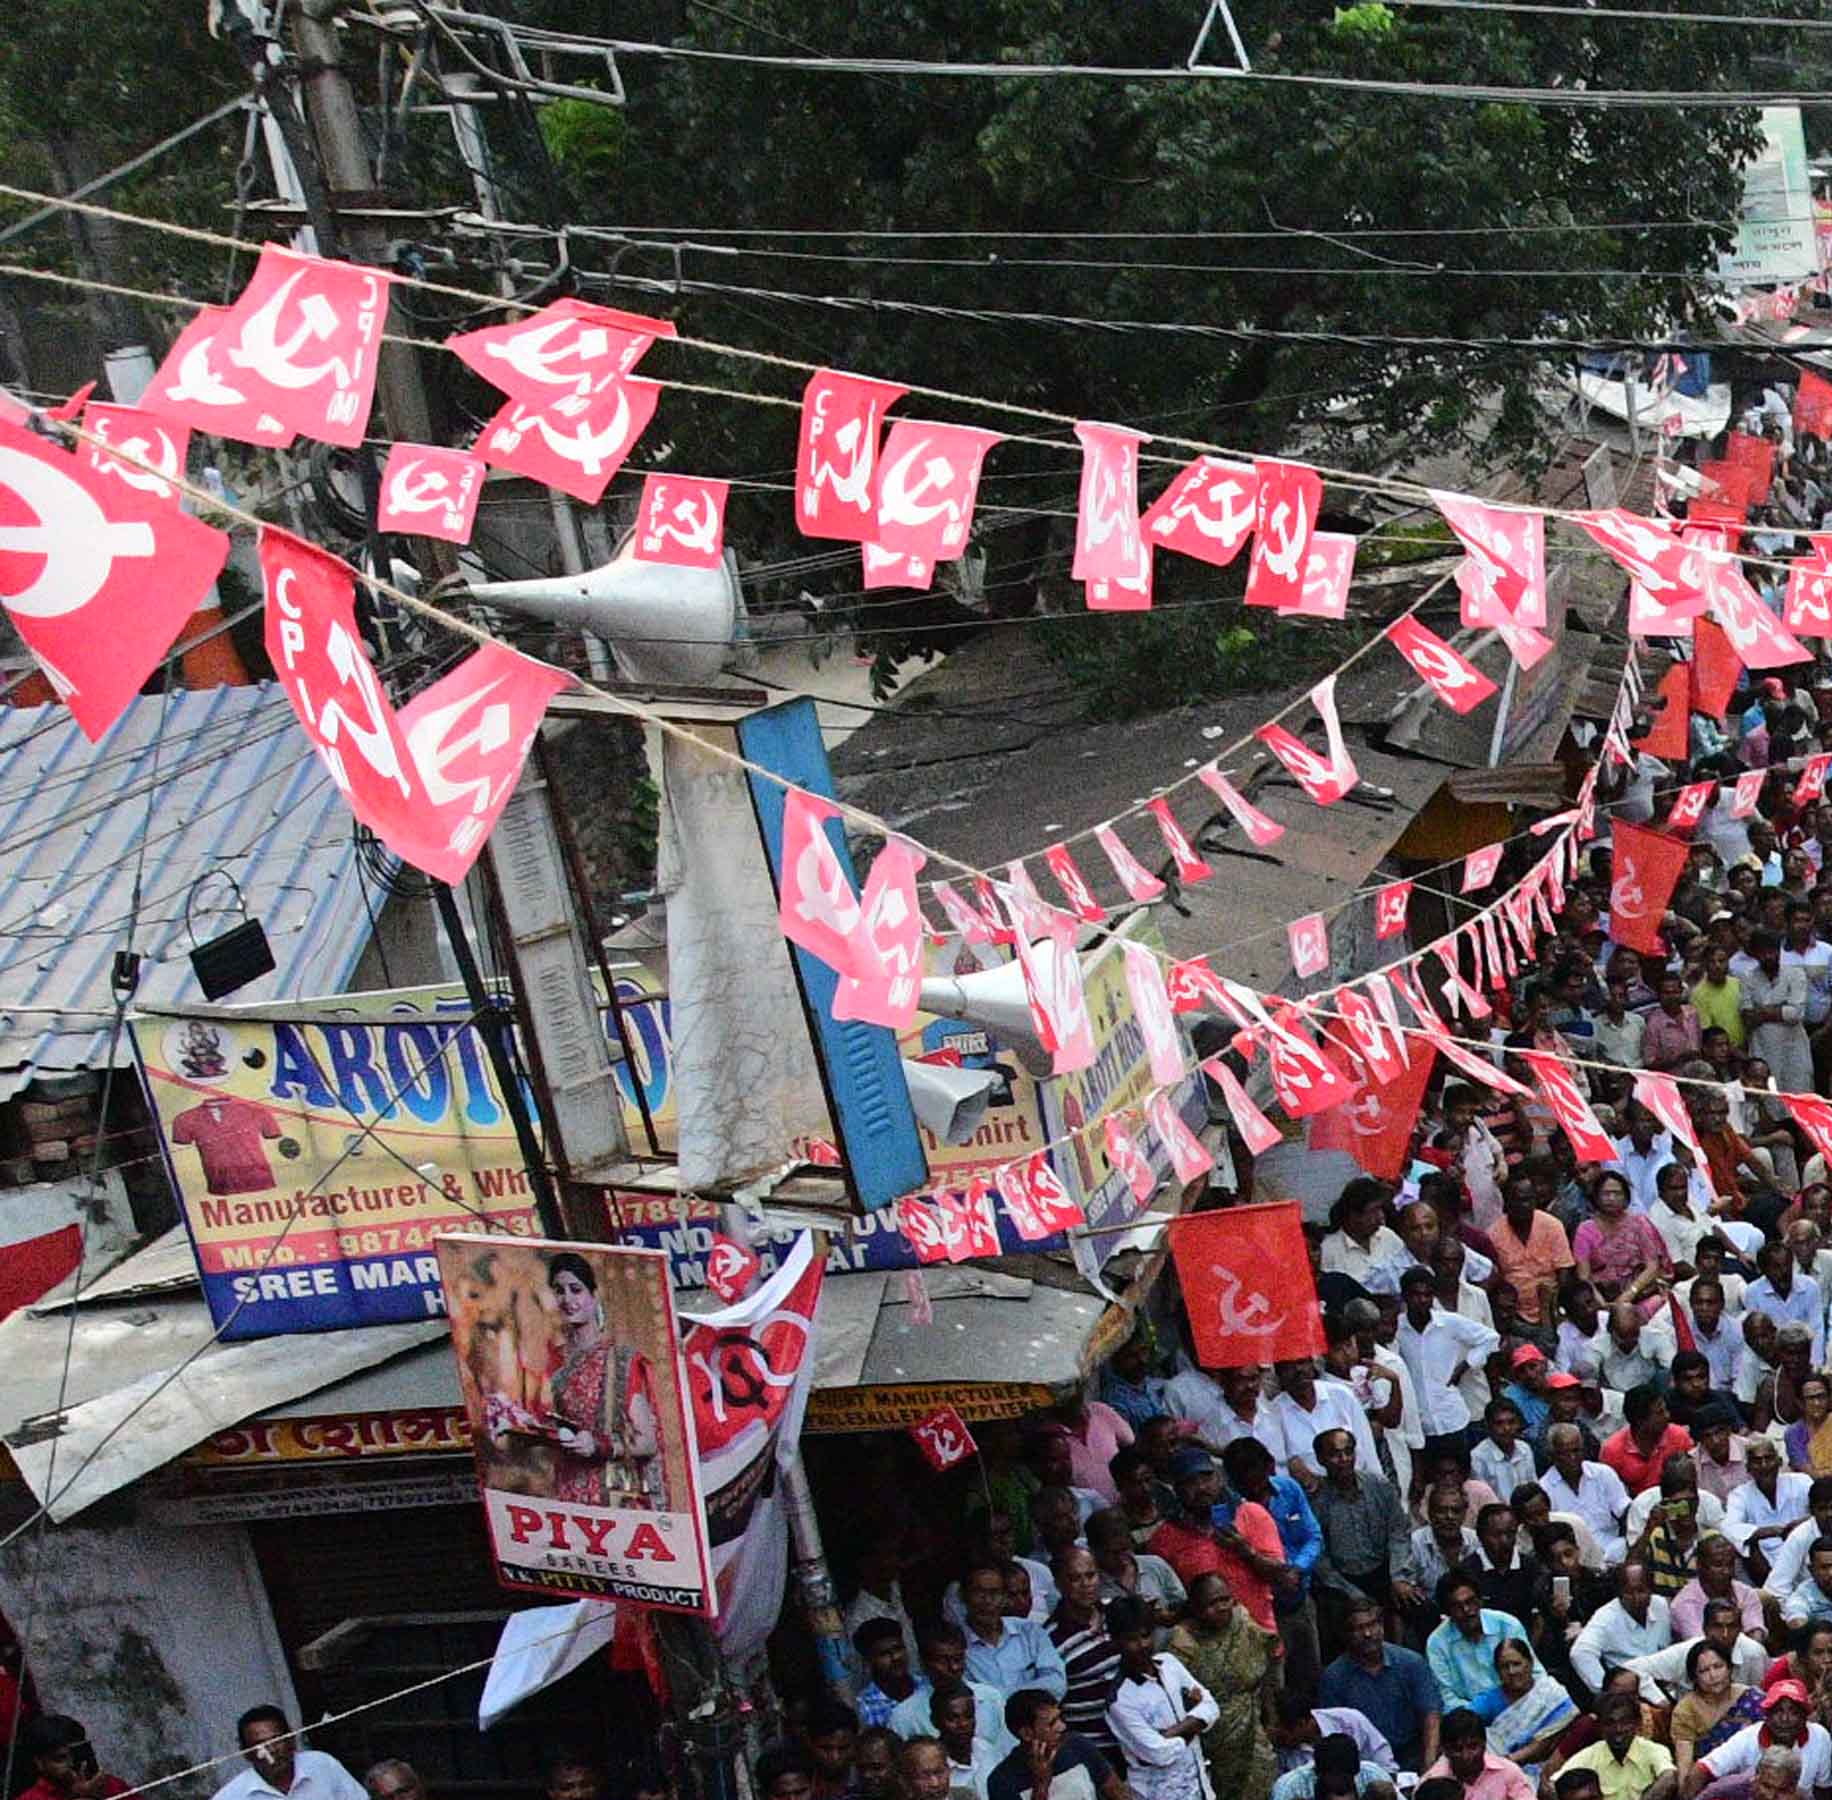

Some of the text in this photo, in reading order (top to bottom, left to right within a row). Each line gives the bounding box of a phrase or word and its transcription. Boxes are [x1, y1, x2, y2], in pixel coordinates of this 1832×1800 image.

[200, 1182, 429, 1230] Manufacturer
[441, 1173, 465, 1200] &
[232, 1267, 339, 1304] SREE
[506, 1504, 677, 1562] PIYA
[546, 1552, 637, 1578] SAREES
[612, 1581, 700, 1608] PRODUCT
